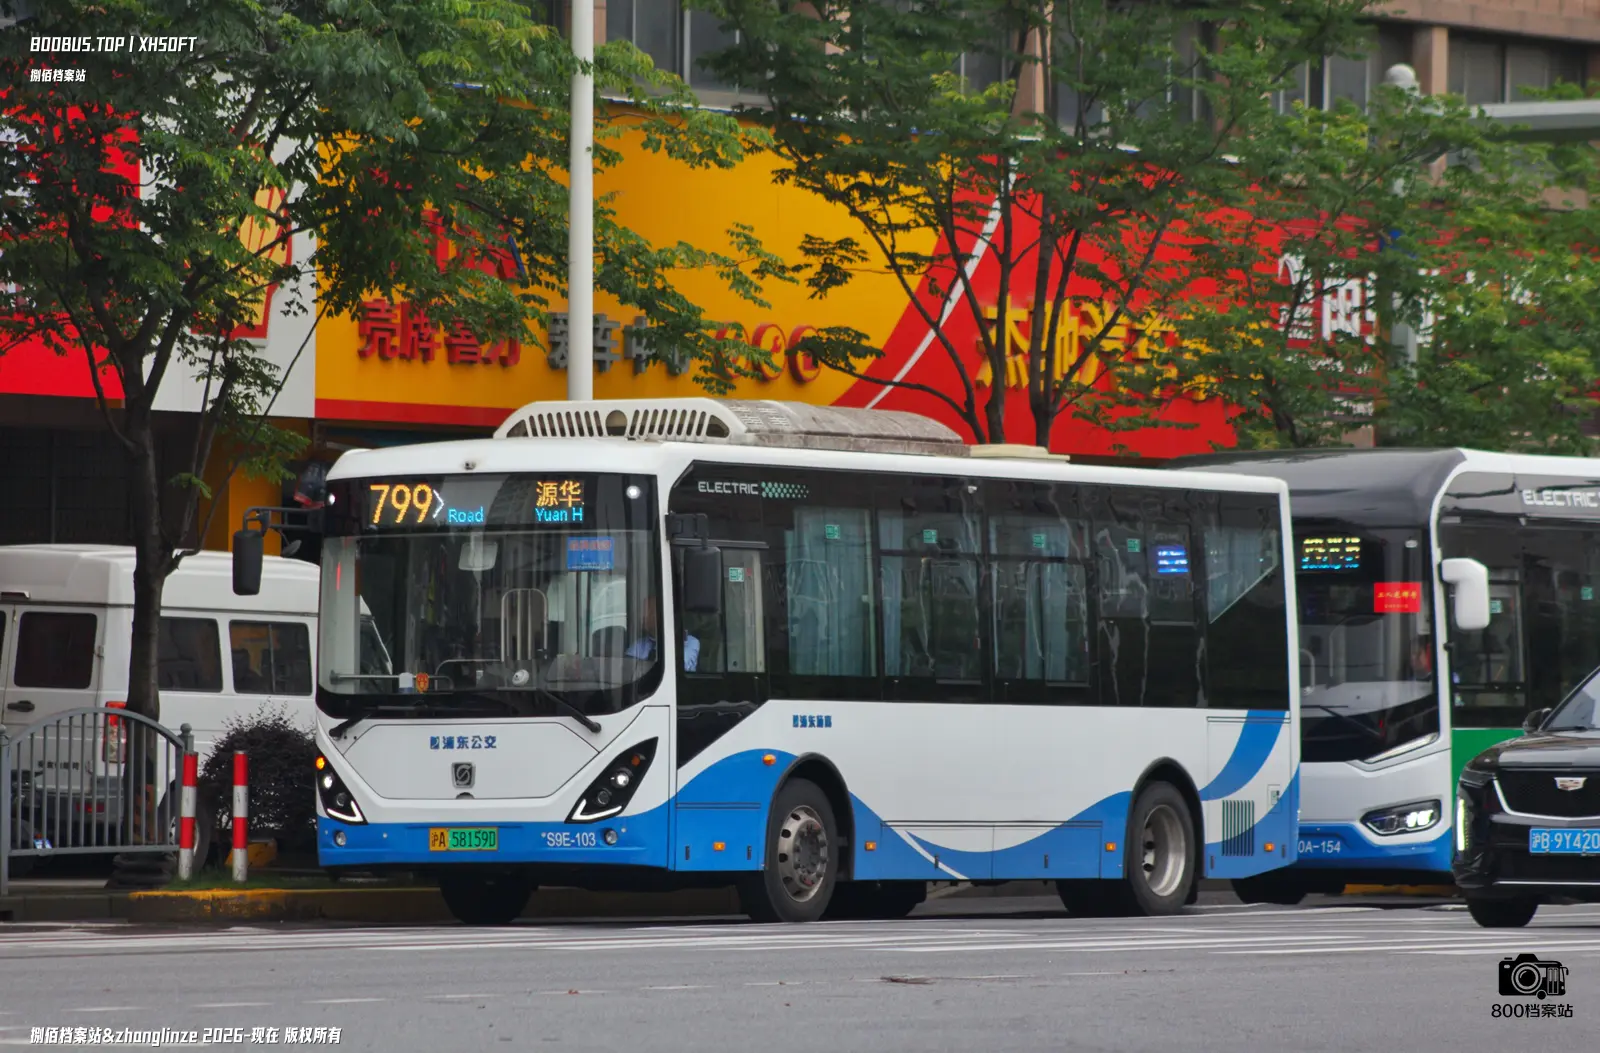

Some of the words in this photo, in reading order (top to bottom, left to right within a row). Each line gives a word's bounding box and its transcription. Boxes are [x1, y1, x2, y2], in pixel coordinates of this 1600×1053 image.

[536, 480, 584, 508] 源华
[698, 481, 759, 495] ELECTRIC
[370, 484, 433, 524] 799
[1522, 489, 1598, 507] ELECTRIC
[448, 507, 484, 523] Road
[535, 507, 568, 522] Yuan
[442, 735, 497, 750] 浦东公交
[547, 832, 596, 847] S9E-103
